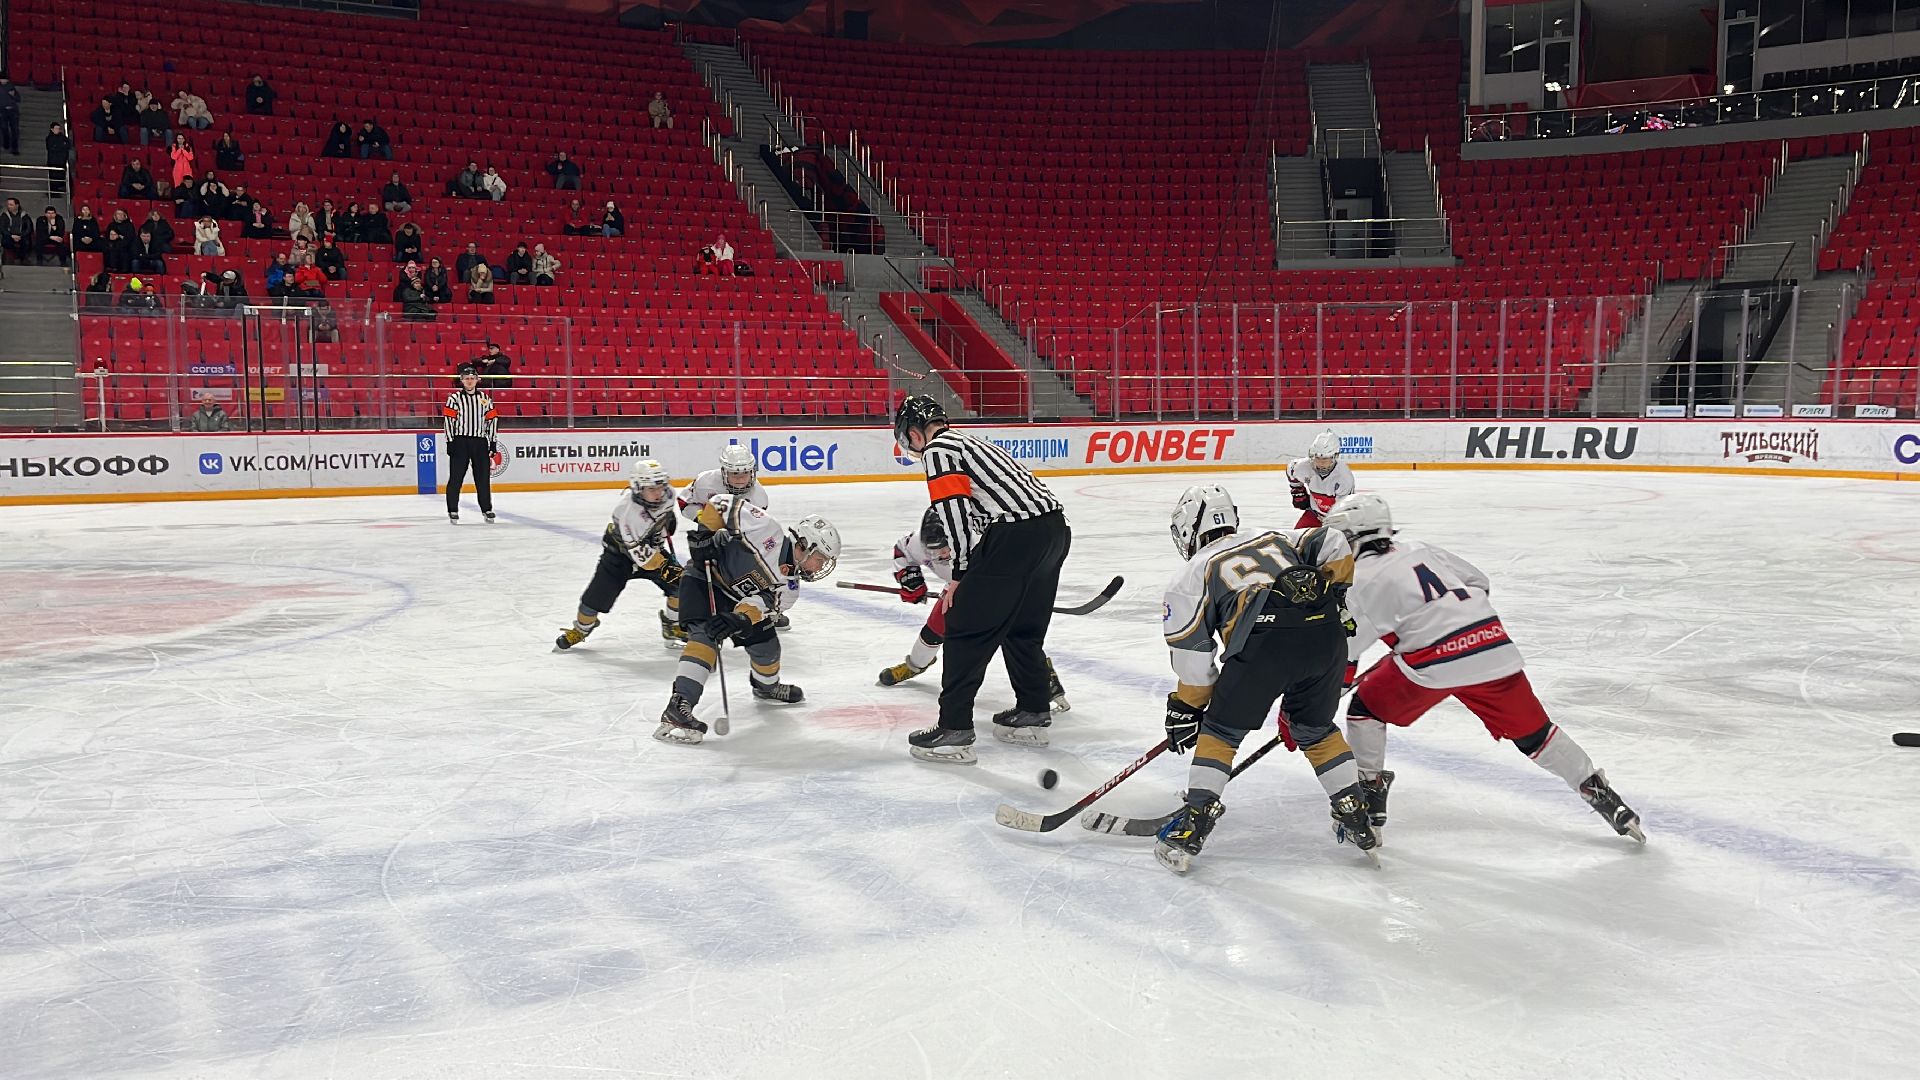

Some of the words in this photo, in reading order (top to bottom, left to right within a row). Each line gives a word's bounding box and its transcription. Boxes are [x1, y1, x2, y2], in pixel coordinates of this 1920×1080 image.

[515, 445, 584, 459] БИЛЕТЫ
[587, 441, 650, 458] ОНЛАЙН
[1085, 429, 1235, 464] FONBET
[1464, 426, 1639, 460] KHL.RU
[1720, 428, 1819, 461] ТУЛЬСКИЙ
[229, 453, 405, 473] VK.COM/HCVITYAZ
[540, 461, 620, 474] HCVITYAZ.RU
[1213, 512, 1226, 526] 61
[1413, 563, 1472, 603] 4
